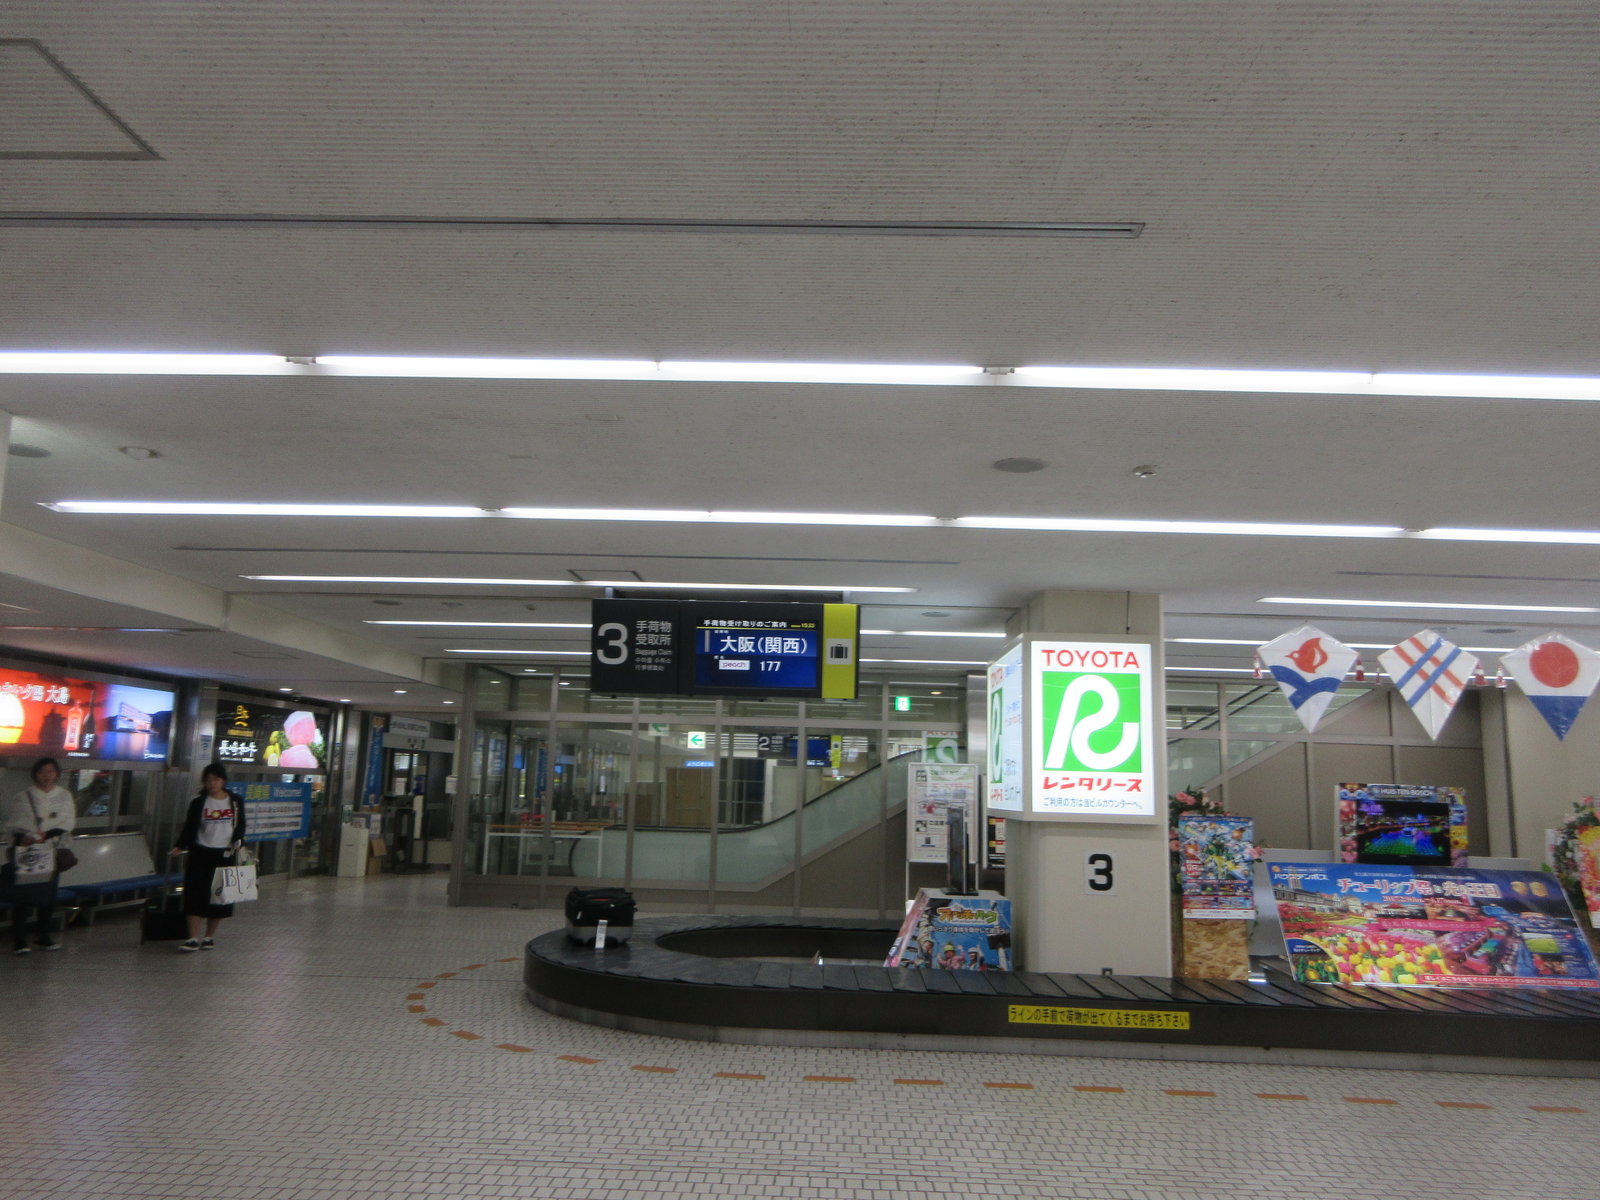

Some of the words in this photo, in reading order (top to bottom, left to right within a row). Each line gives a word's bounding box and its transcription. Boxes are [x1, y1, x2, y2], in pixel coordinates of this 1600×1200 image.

[635, 620, 672, 633] 手荷物
[703, 619, 788, 629] 手荷物受け取りのご案内
[597, 622, 629, 665] 3
[635, 633, 672, 646] 受取所
[722, 661, 747, 669] peach
[759, 660, 782, 672] 177
[1041, 649, 1140, 669] TOYOTA
[758, 736, 770, 751] 2
[1042, 776, 1143, 793] レンタリース
[1088, 853, 1114, 892] 3
[1274, 873, 1329, 881] ハウステンボス
